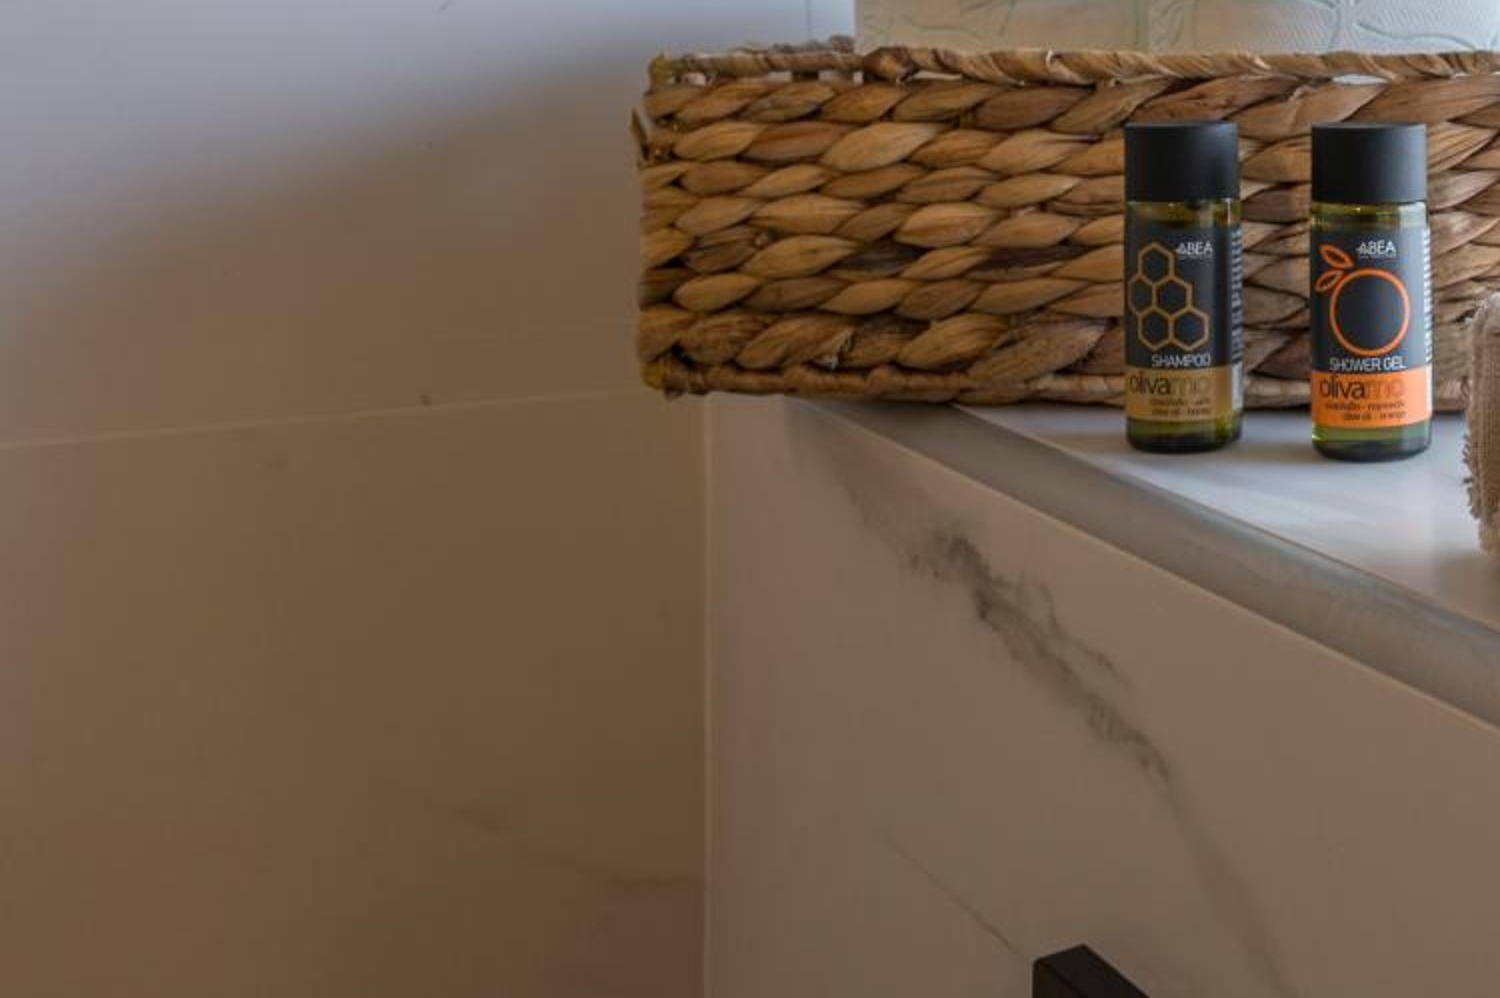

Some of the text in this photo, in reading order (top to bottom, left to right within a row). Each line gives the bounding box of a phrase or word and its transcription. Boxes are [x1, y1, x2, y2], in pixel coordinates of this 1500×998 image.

[1176, 241, 1213, 255] ABEA
[1356, 240, 1398, 255] ABEA
[1151, 353, 1211, 368] SHAMPOO
[1329, 355, 1407, 371] SHOWER GEL
